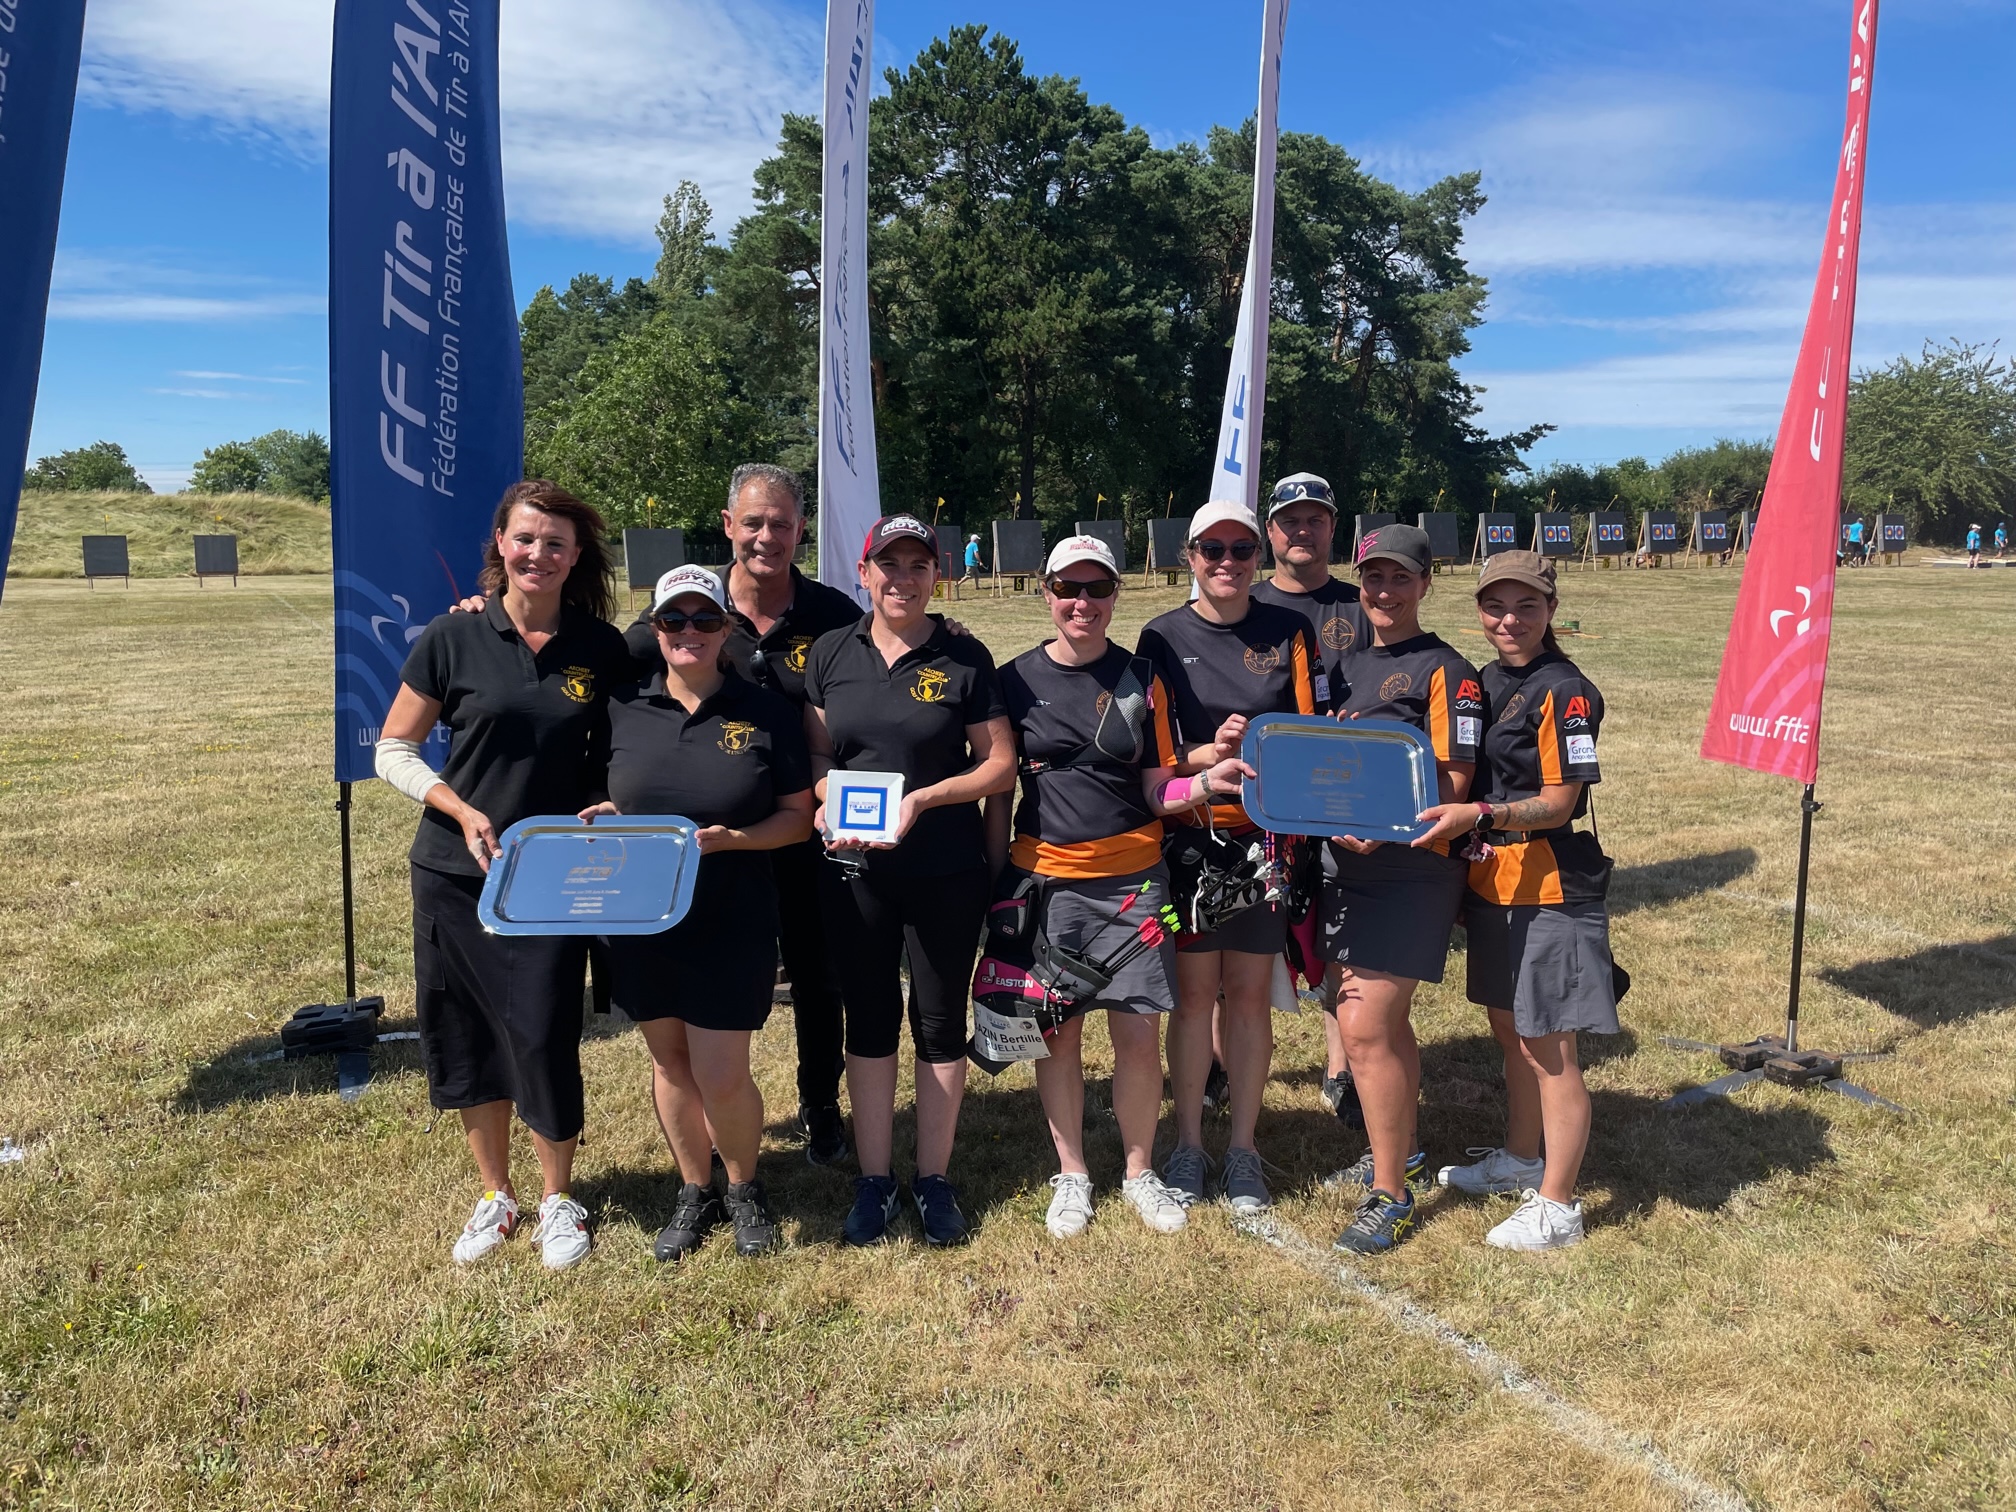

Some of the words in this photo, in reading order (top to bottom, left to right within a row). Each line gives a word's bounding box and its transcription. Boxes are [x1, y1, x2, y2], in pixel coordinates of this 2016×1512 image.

[446, 51, 470, 74] à
[445, 77, 469, 118] Tir
[443, 126, 468, 167] de
[387, 147, 436, 210] à
[437, 174, 470, 328] Française
[382, 218, 433, 336] Tir
[380, 349, 428, 488] FF
[431, 334, 461, 497] Fédération
[1016, 577, 1022, 590] 6
[1169, 572, 1175, 585] 8
[935, 584, 941, 597] 5
[1183, 656, 1200, 664] ST
[1455, 678, 1482, 702] AB
[996, 977, 1034, 988] EASTON
[985, 1038, 1027, 1052] RUELLE
[999, 1033, 1042, 1043] Bertille
